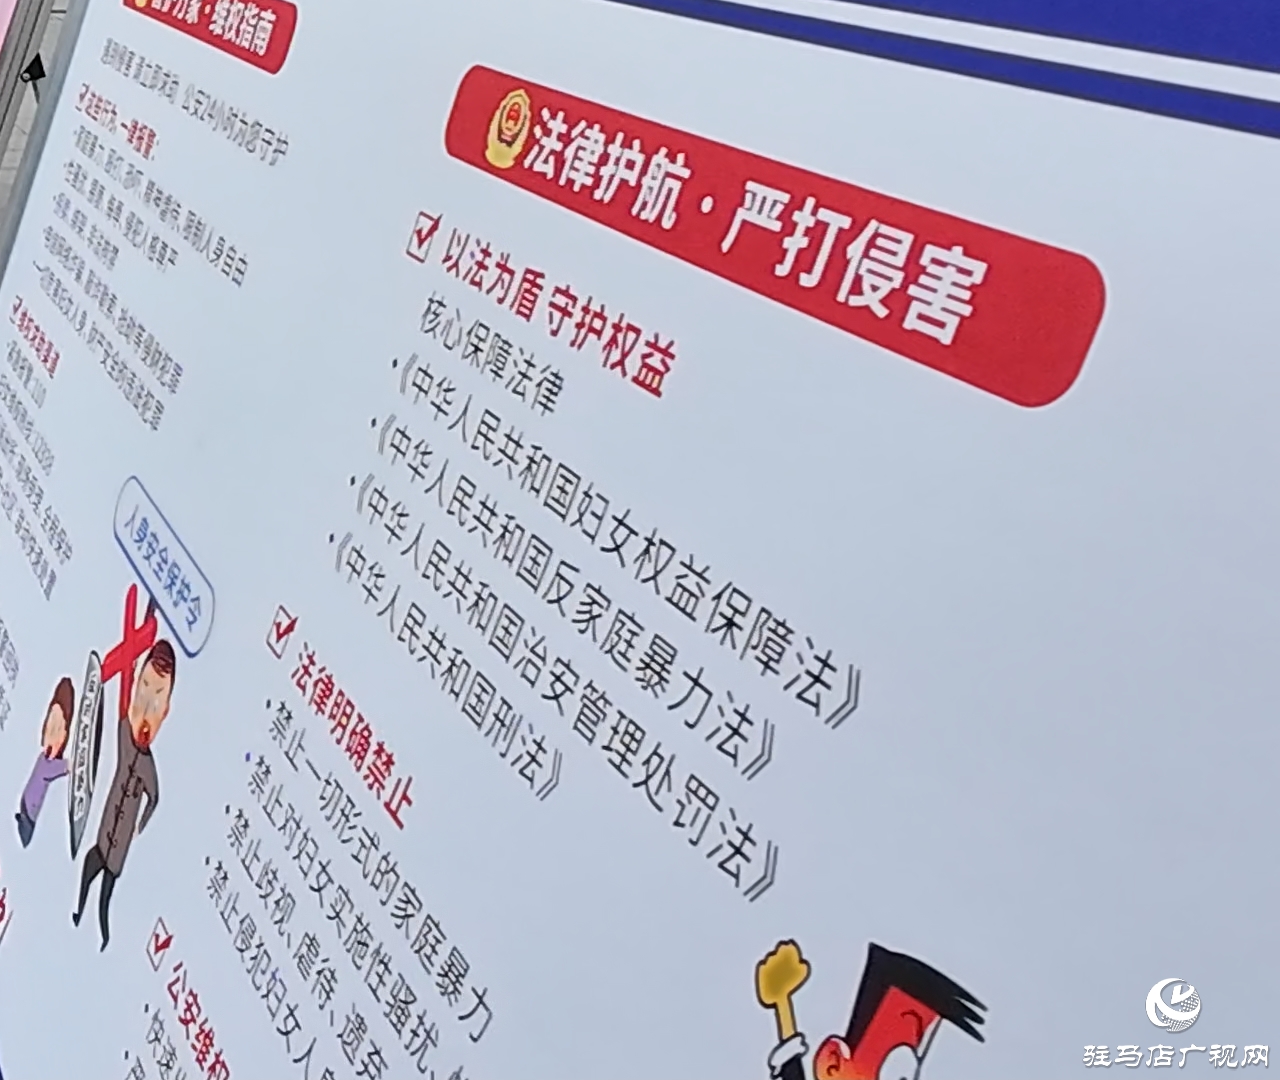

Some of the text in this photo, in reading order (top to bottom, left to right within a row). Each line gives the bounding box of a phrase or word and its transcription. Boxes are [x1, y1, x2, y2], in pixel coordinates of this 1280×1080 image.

[438, 223, 681, 403] 以法为盾 守护权益
[519, 102, 996, 360] 法律护航·严打侵害
[415, 288, 568, 425] 核心保障法律
[122, 497, 205, 639] 人身安全保护令
[289, 636, 420, 835] 法律明确禁止
[204, 853, 335, 1080] 禁止侵犯妇女人
[245, 747, 467, 1080] 禁止对妇女实施性骚扰、
[267, 693, 498, 1056] 禁止一切形式的家庭暴力
